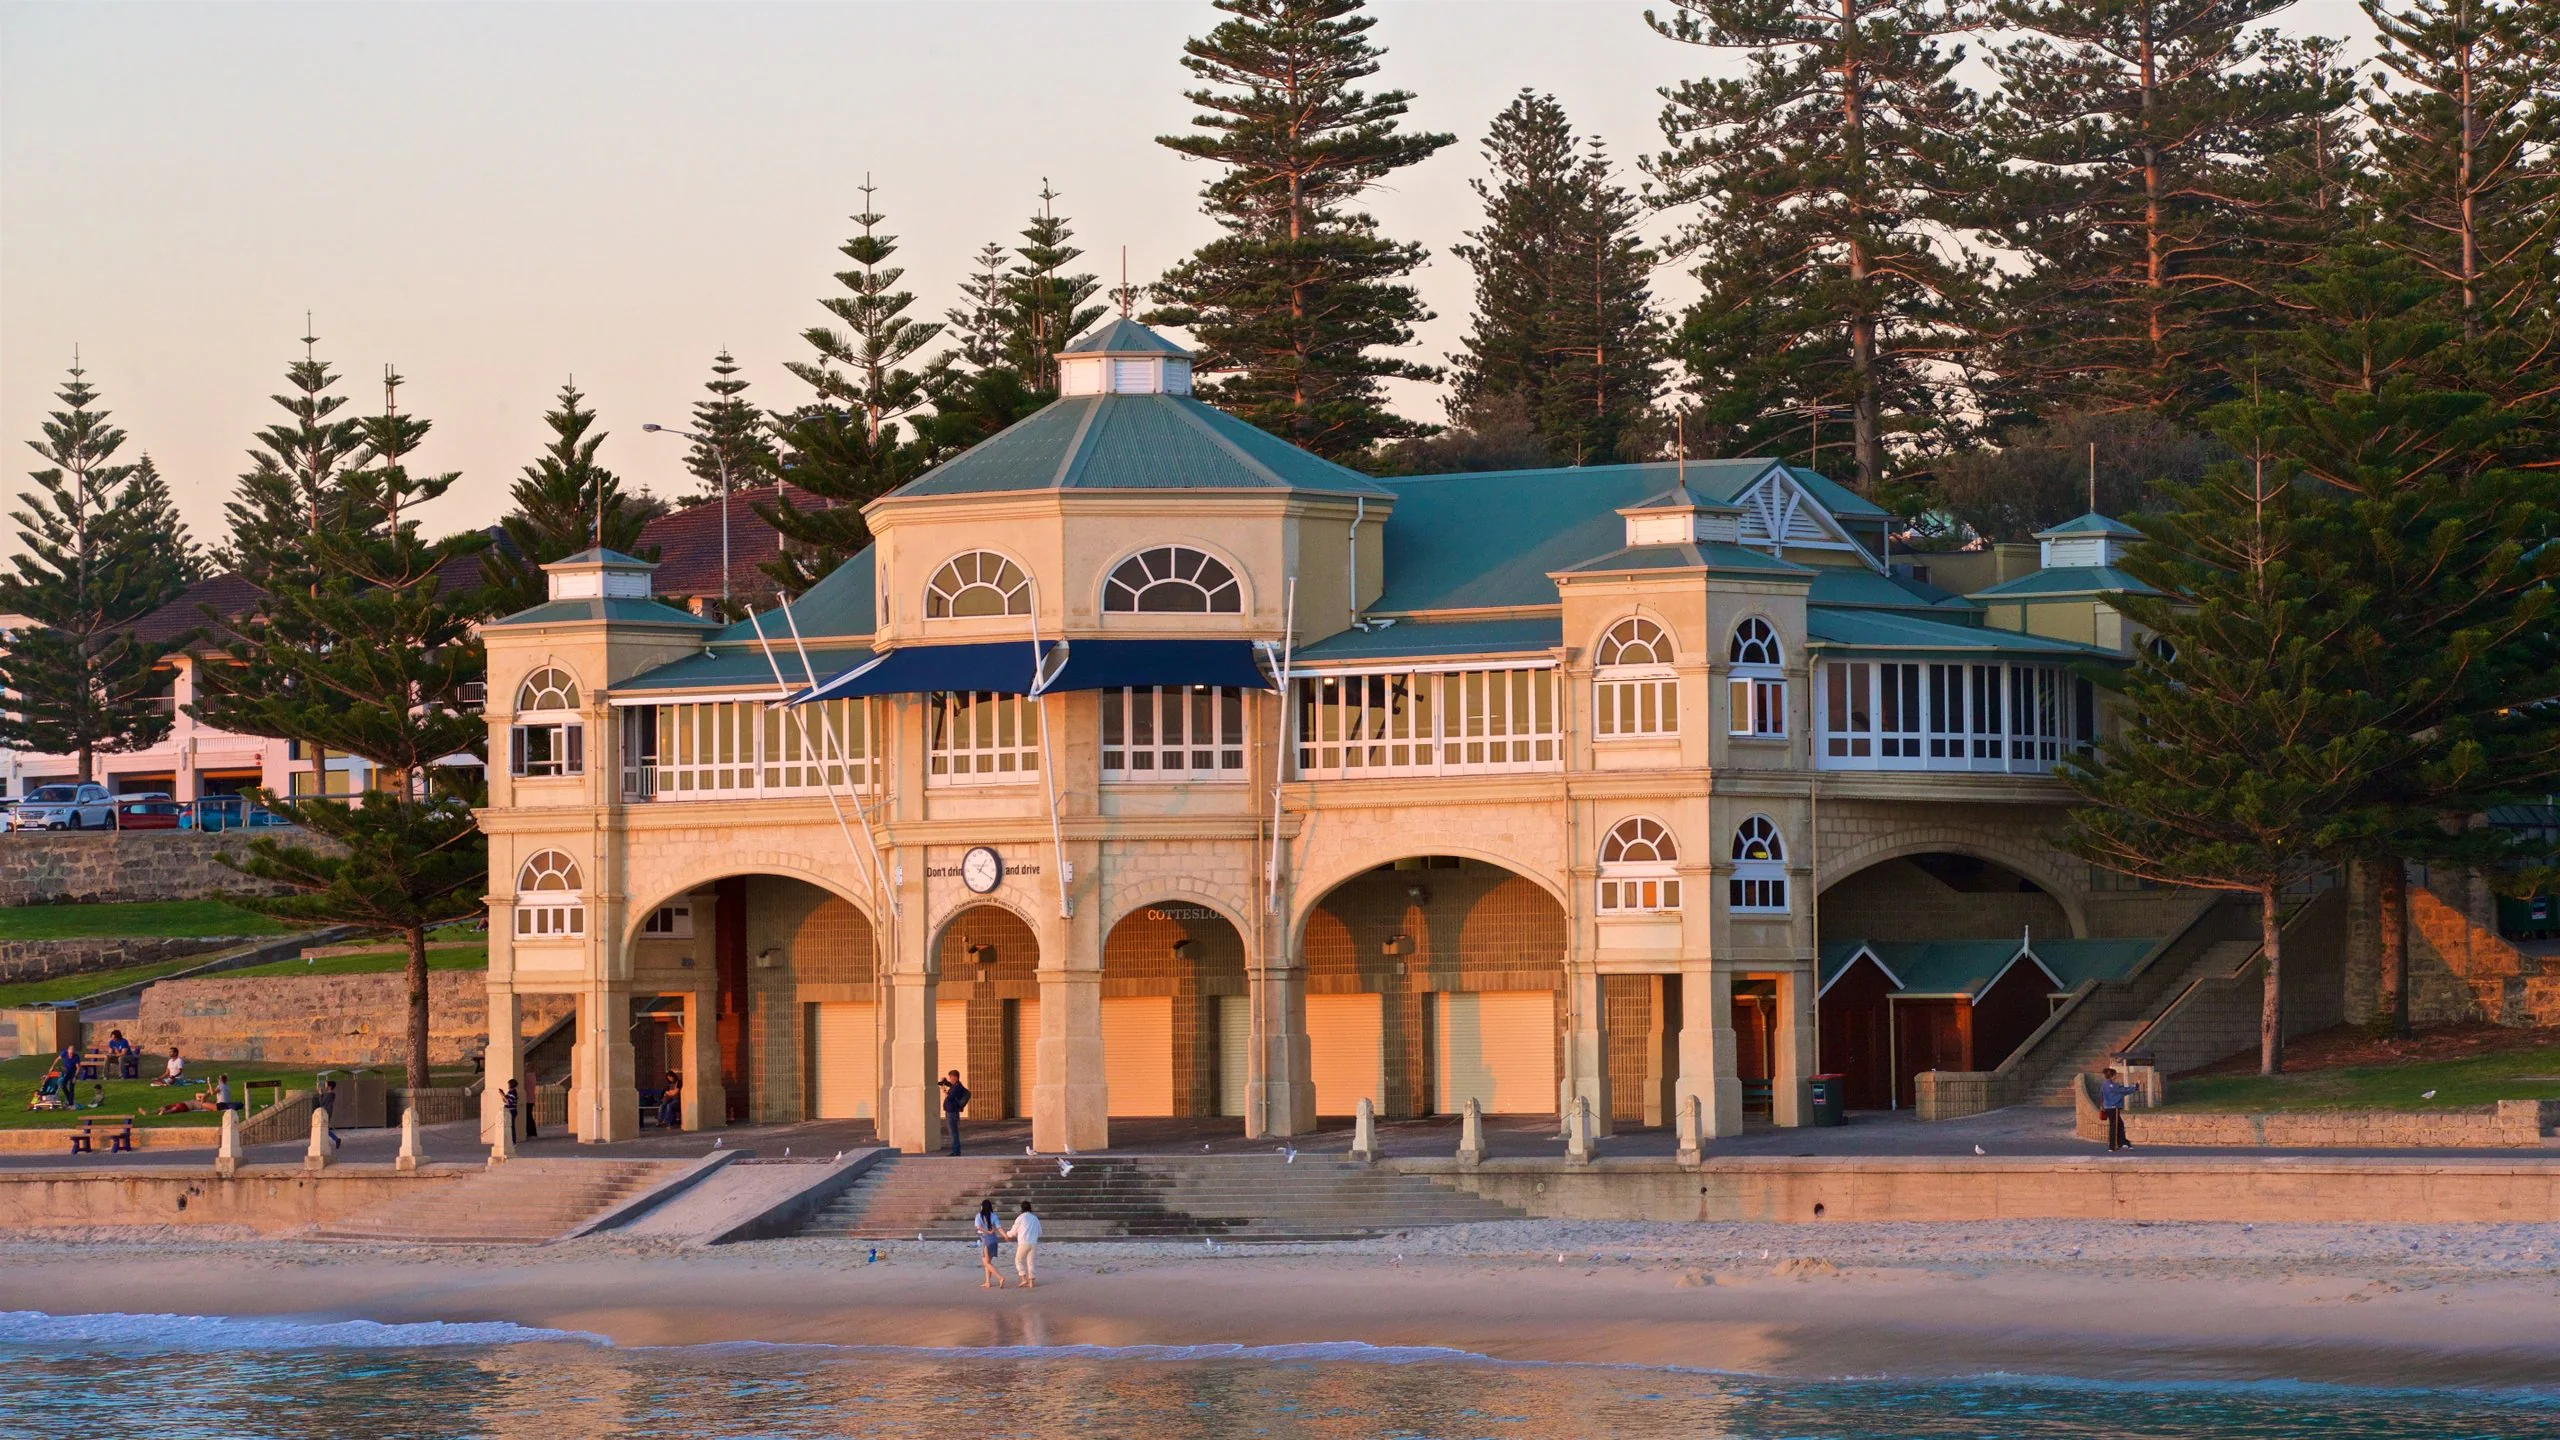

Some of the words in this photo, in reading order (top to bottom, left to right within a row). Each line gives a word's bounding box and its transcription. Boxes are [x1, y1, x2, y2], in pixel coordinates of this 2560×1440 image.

[927, 866, 946, 877] Don't
[948, 866, 963, 877] drin
[1005, 864, 1020, 875] and
[1021, 864, 1040, 875] drive
